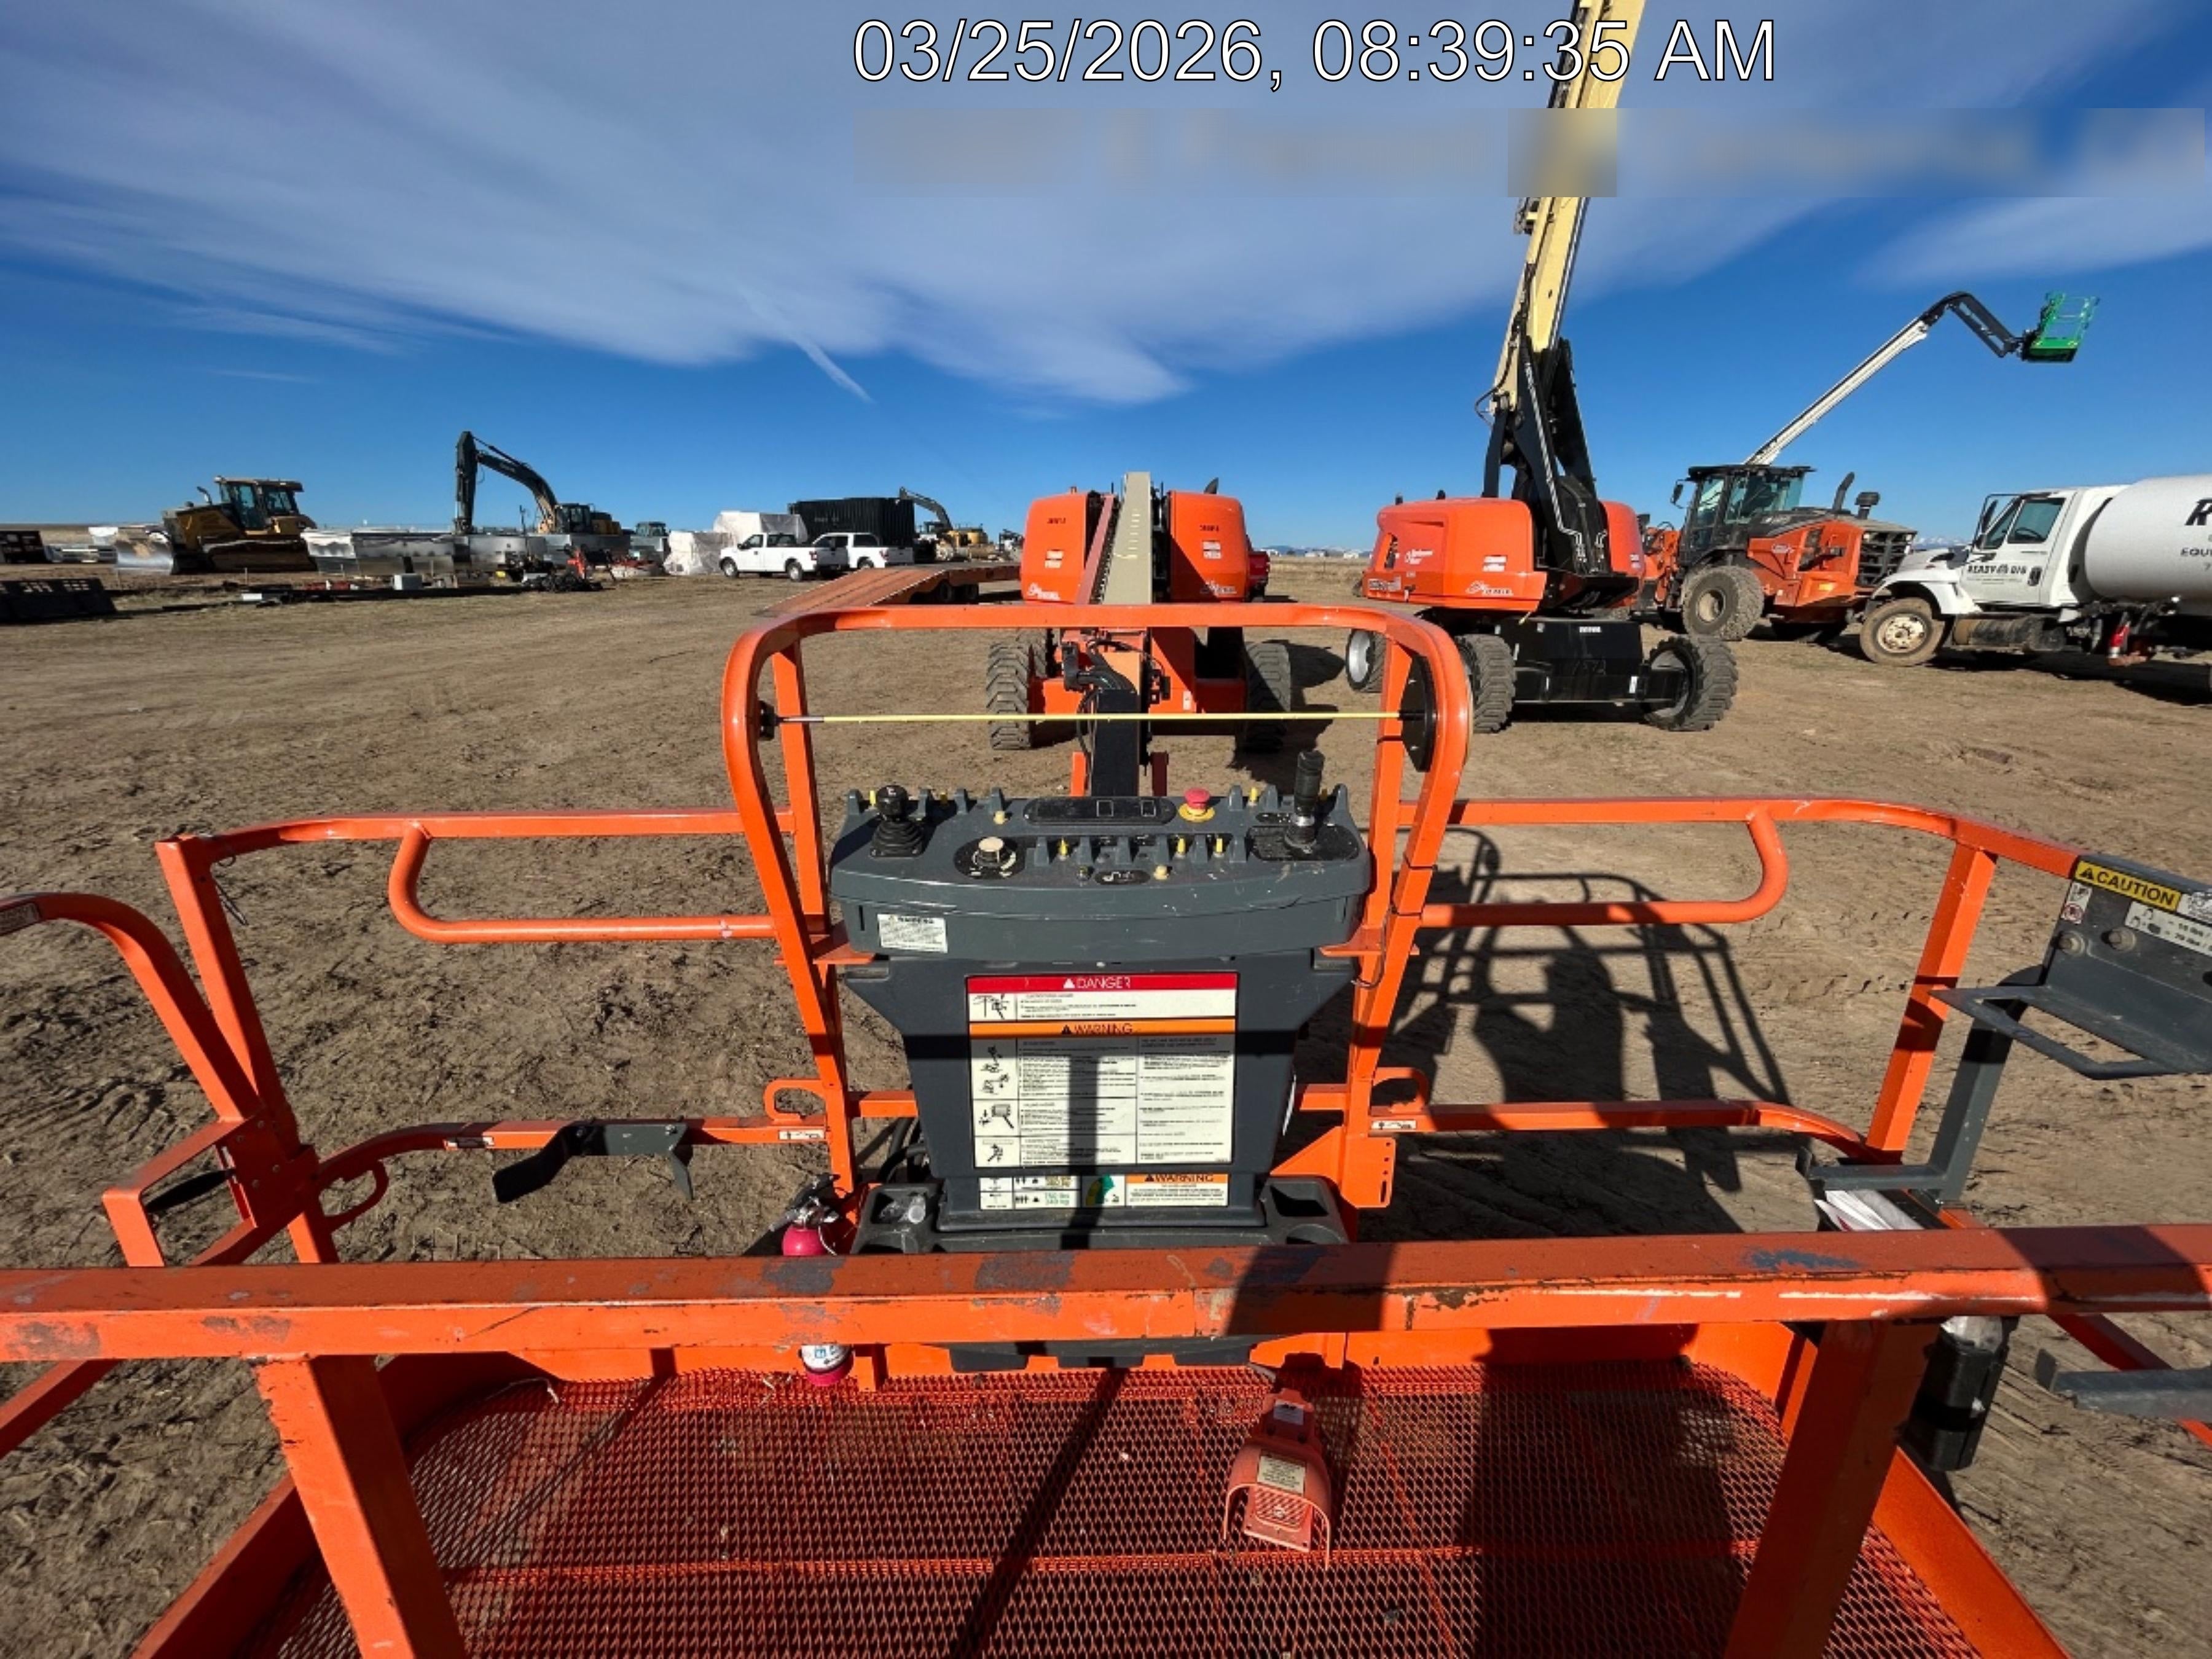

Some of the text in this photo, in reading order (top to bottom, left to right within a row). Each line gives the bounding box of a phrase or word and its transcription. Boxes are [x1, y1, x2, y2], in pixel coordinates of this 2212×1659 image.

[2097, 871, 2175, 905] CAUTION
[1077, 976, 1131, 989] DANGER
[1074, 1022, 1133, 1035] WARNING
[1155, 1174, 1214, 1182] WARNING
